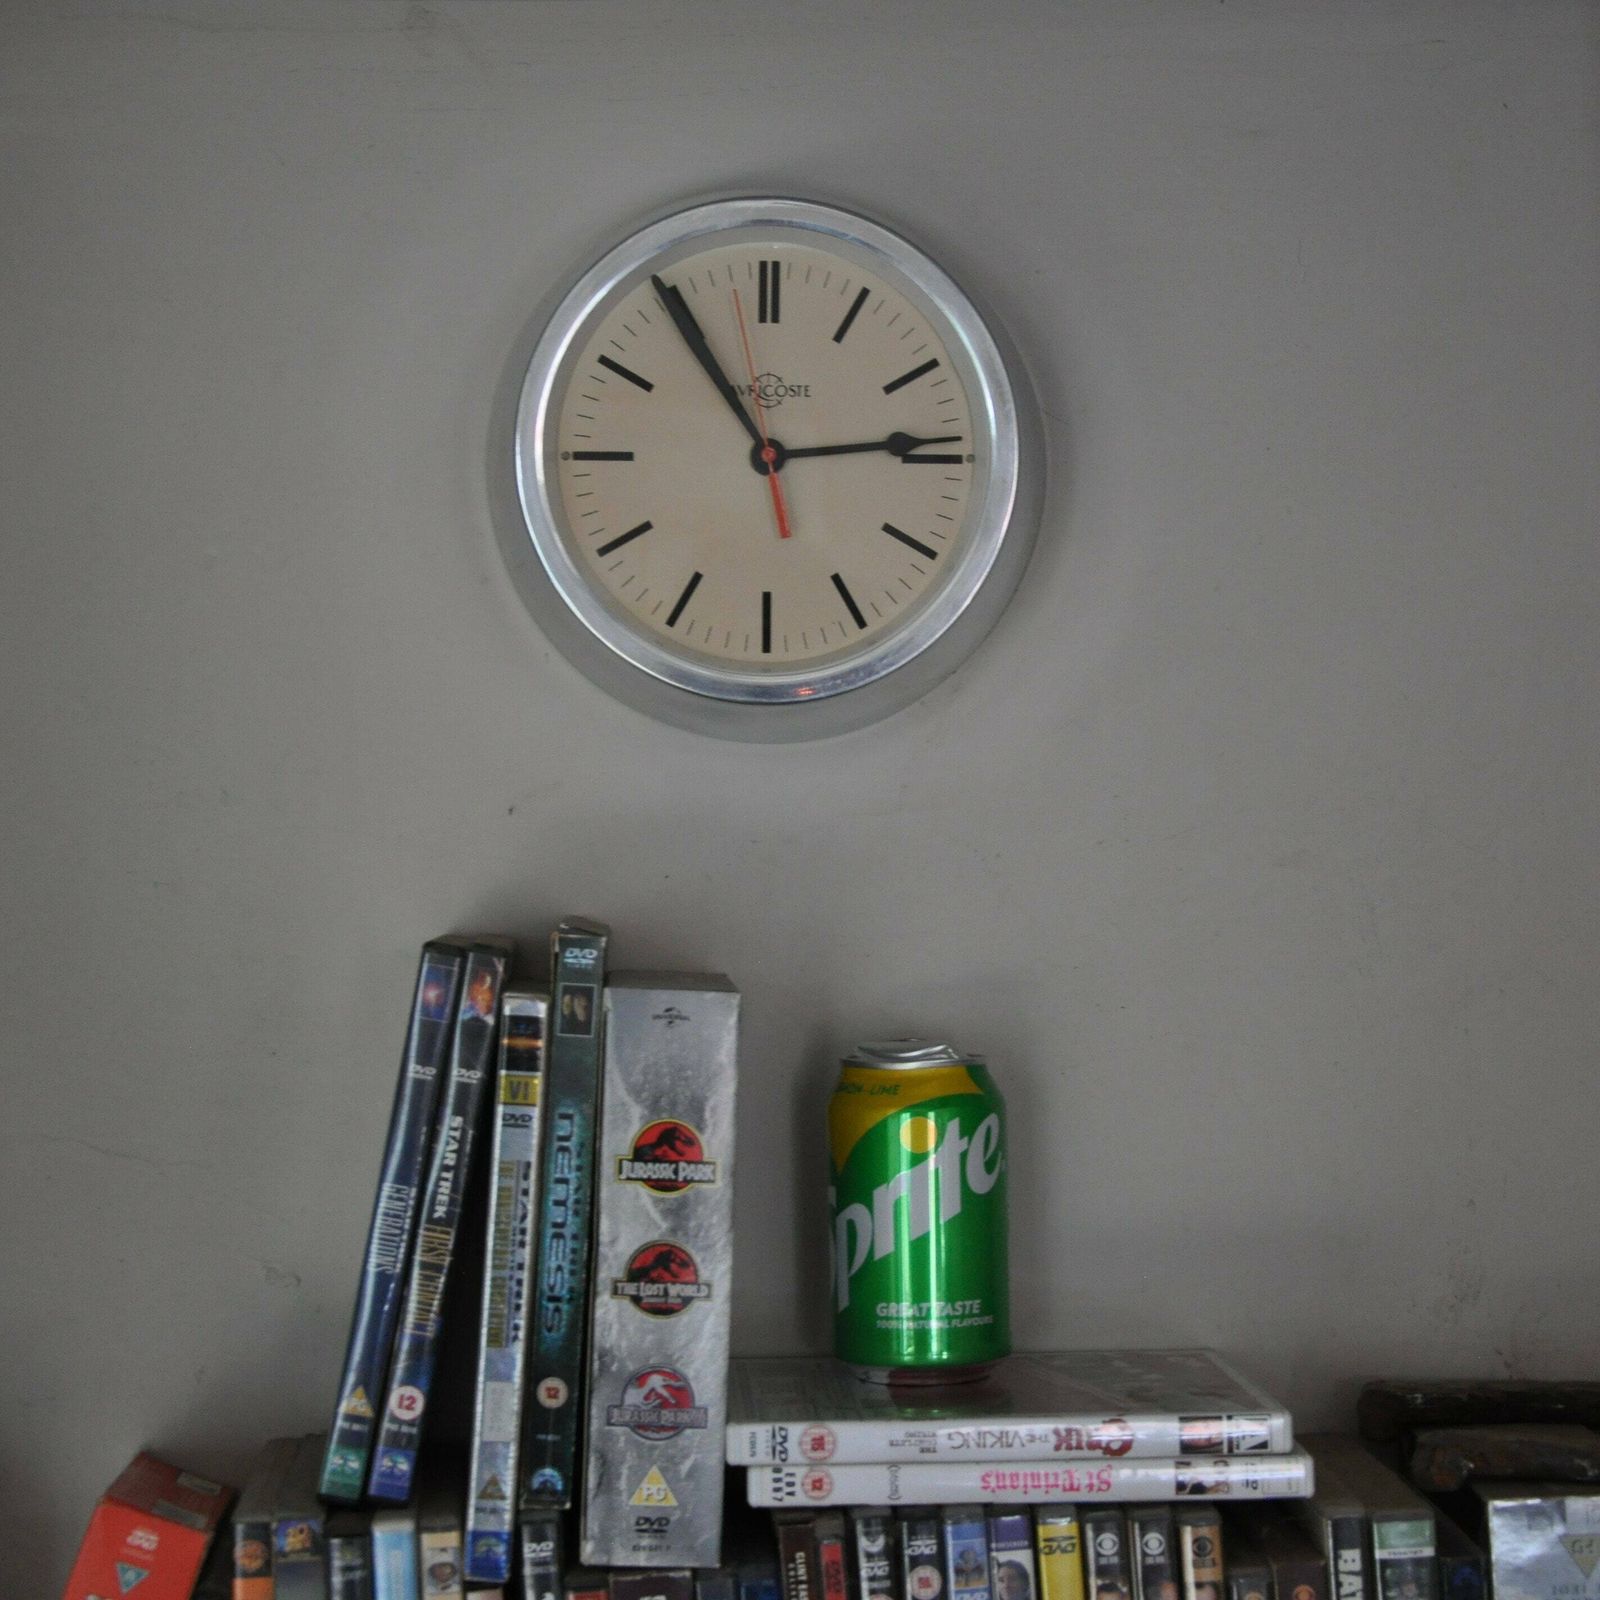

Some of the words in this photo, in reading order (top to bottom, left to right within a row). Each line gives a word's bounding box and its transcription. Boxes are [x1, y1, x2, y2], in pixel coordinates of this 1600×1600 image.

[564, 947, 598, 959] DVD
[509, 1079, 530, 1100] VI
[502, 1113, 532, 1124] DVD
[443, 1115, 464, 1167] STAR
[619, 1160, 678, 1181] JURASSIC
[678, 1160, 717, 1182] PARK
[432, 1170, 455, 1219] TREK
[829, 1112, 1001, 1312] prite
[367, 1183, 410, 1275] GENERATIONS
[414, 1223, 454, 1265] FIRST
[615, 1281, 639, 1296] THE
[639, 1281, 668, 1298] LOST
[667, 1283, 709, 1298] WORLD
[405, 1268, 447, 1338] CONTACT
[876, 1301, 931, 1317] GREAT
[934, 1299, 982, 1316] TASTE
[397, 1393, 417, 1411] 12
[777, 1426, 789, 1462] DVD
[948, 1430, 1025, 1449] VIKING
[785, 1472, 796, 1497] EDV
[981, 1469, 1081, 1494] Trinian's
[1086, 1464, 1113, 1493] St
[642, 1486, 666, 1501] PG
[635, 1516, 670, 1527] DVD
[906, 1544, 938, 1556] DVD
[1040, 1541, 1078, 1556] DVD
[795, 1551, 808, 1581] CLINT
